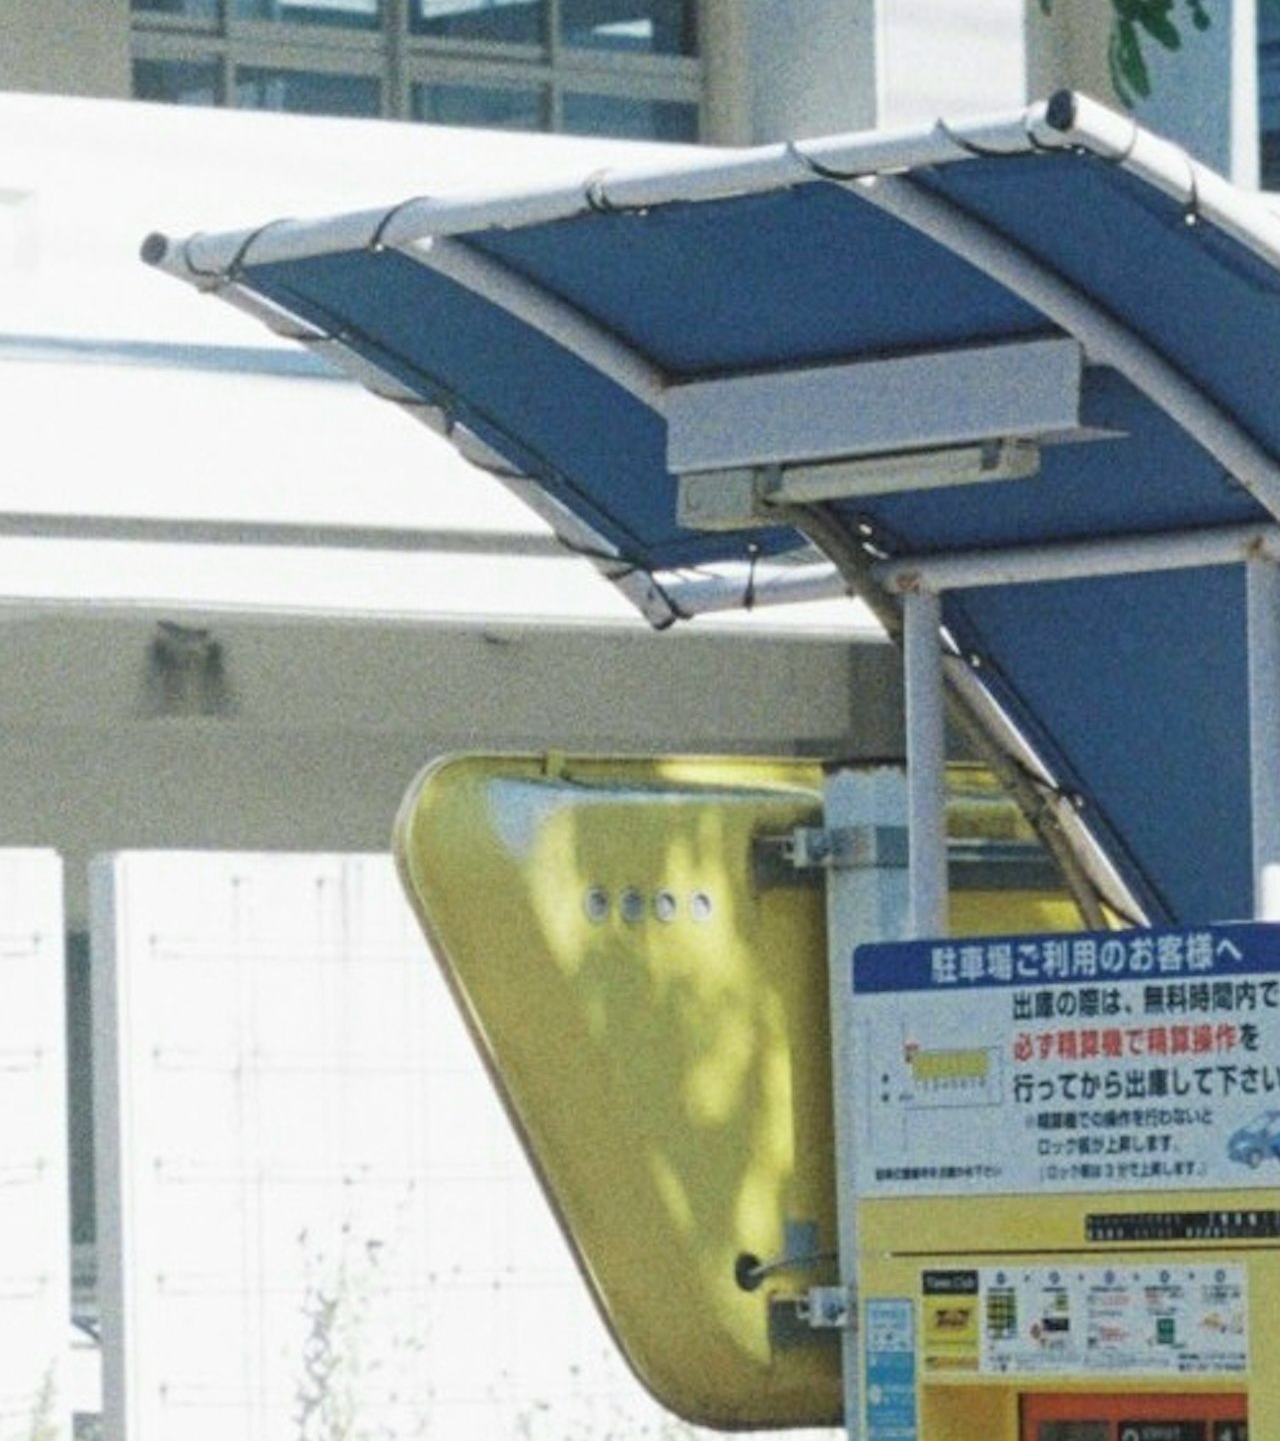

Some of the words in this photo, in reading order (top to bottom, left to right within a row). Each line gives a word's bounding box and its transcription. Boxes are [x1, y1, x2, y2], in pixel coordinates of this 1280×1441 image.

[931, 931, 1243, 983] 駐車場ご利用のお客様へ
[1013, 1023, 1259, 1060] 必ず精算機で精算操作を
